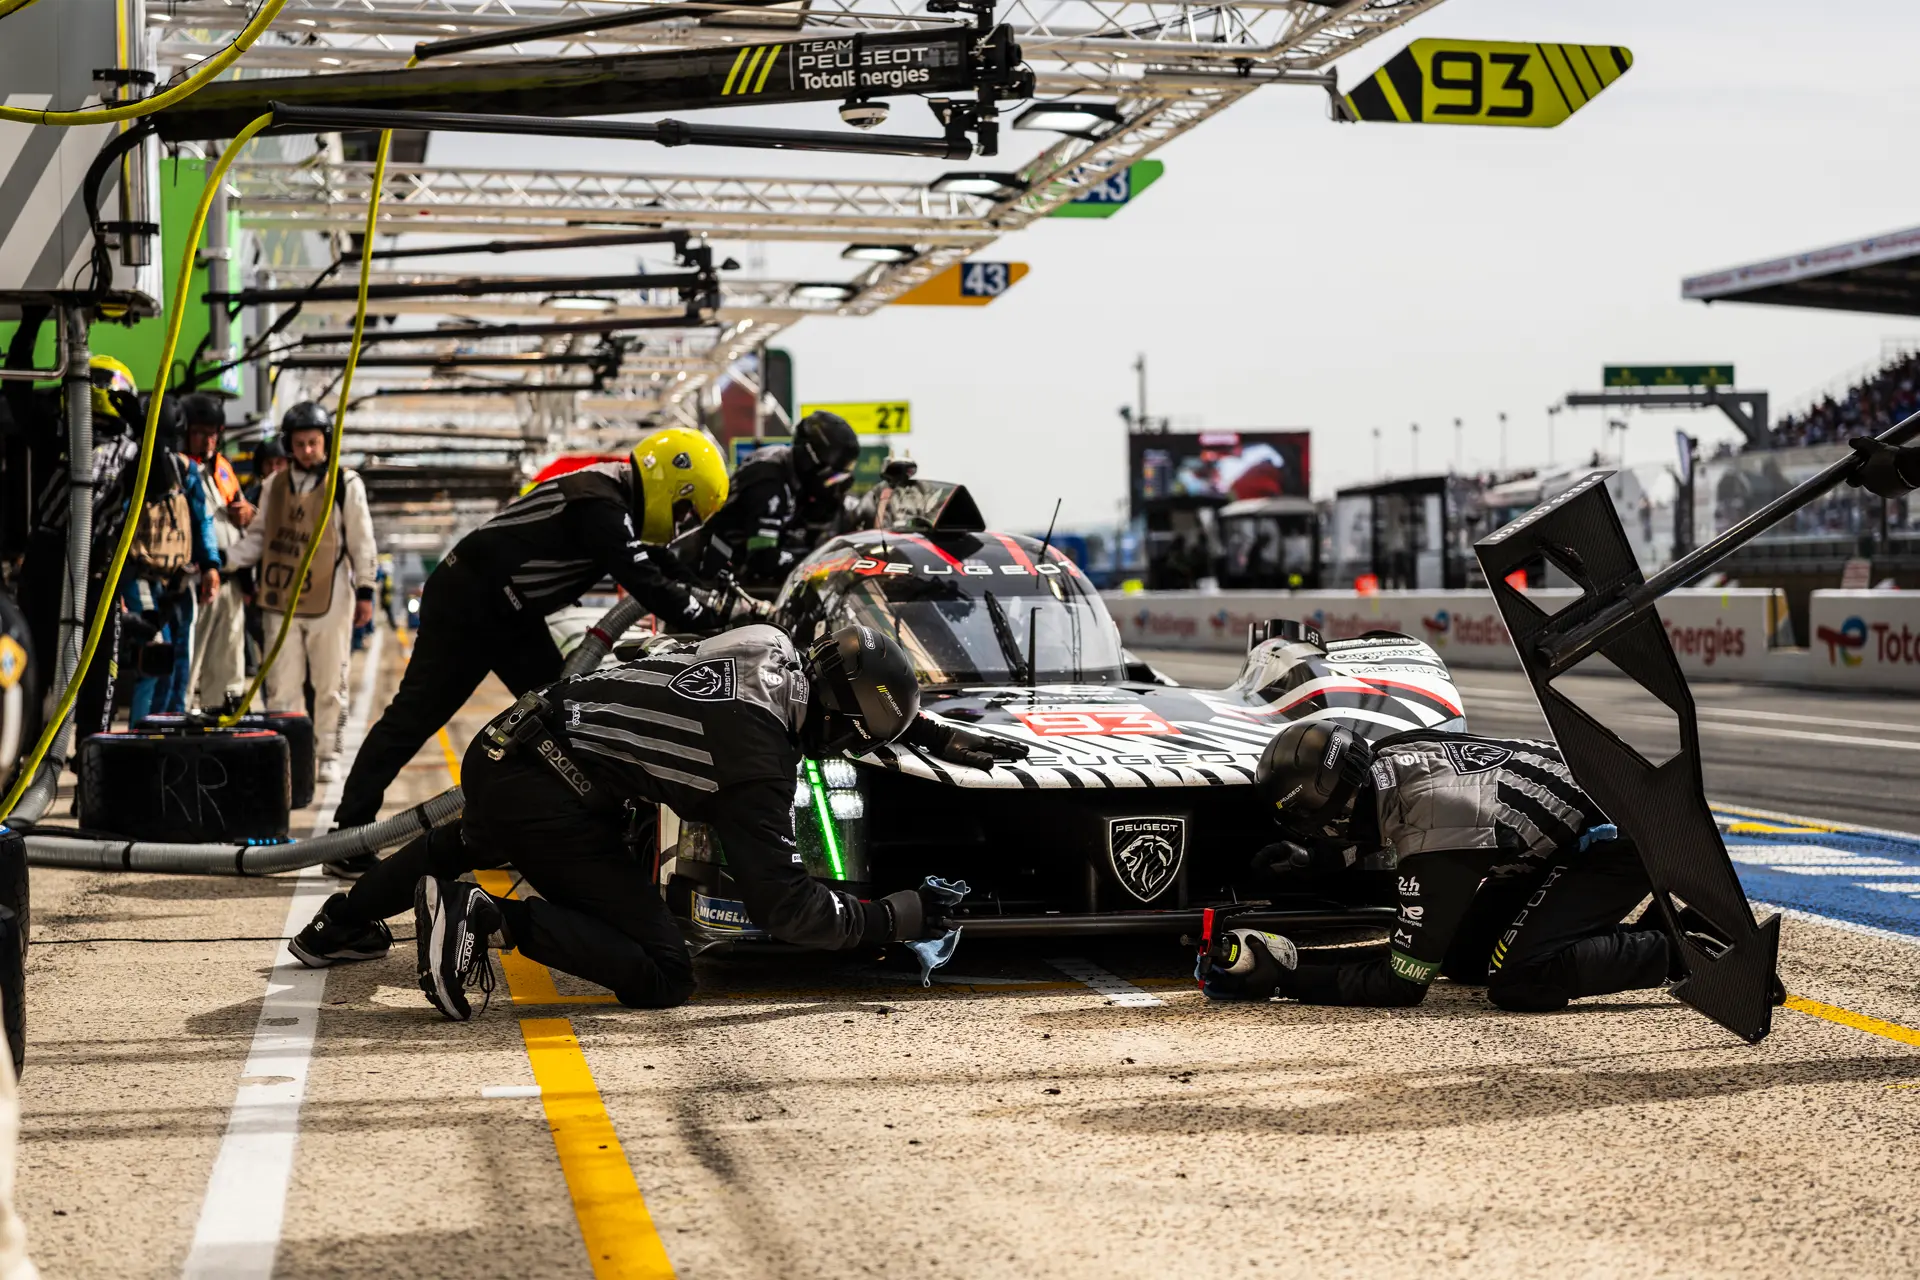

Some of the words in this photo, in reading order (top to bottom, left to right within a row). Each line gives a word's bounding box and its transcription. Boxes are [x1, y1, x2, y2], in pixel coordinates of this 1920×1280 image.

[799, 47, 929, 70] PEUGEOT
[800, 39, 853, 52] TEAM
[800, 65, 930, 90] TotalEnergies
[1431, 50, 1534, 118] 93
[964, 264, 1006, 296] 43
[876, 407, 906, 430] 27
[1551, 474, 1604, 504] PRESS
[1490, 505, 1551, 541] CLUTCH
[851, 560, 1075, 575] PEUGEOT
[723, 661, 731, 697] PEUGEOT
[1026, 713, 1169, 733] 93
[540, 739, 592, 793] sparco
[1447, 742, 1468, 772] PEUGEOT
[161, 752, 227, 831] RR
[1115, 824, 1178, 832] PEUGEOT
[1398, 876, 1420, 892] 24h
[1503, 865, 1569, 946] SPORT
[461, 931, 475, 972] sparco
